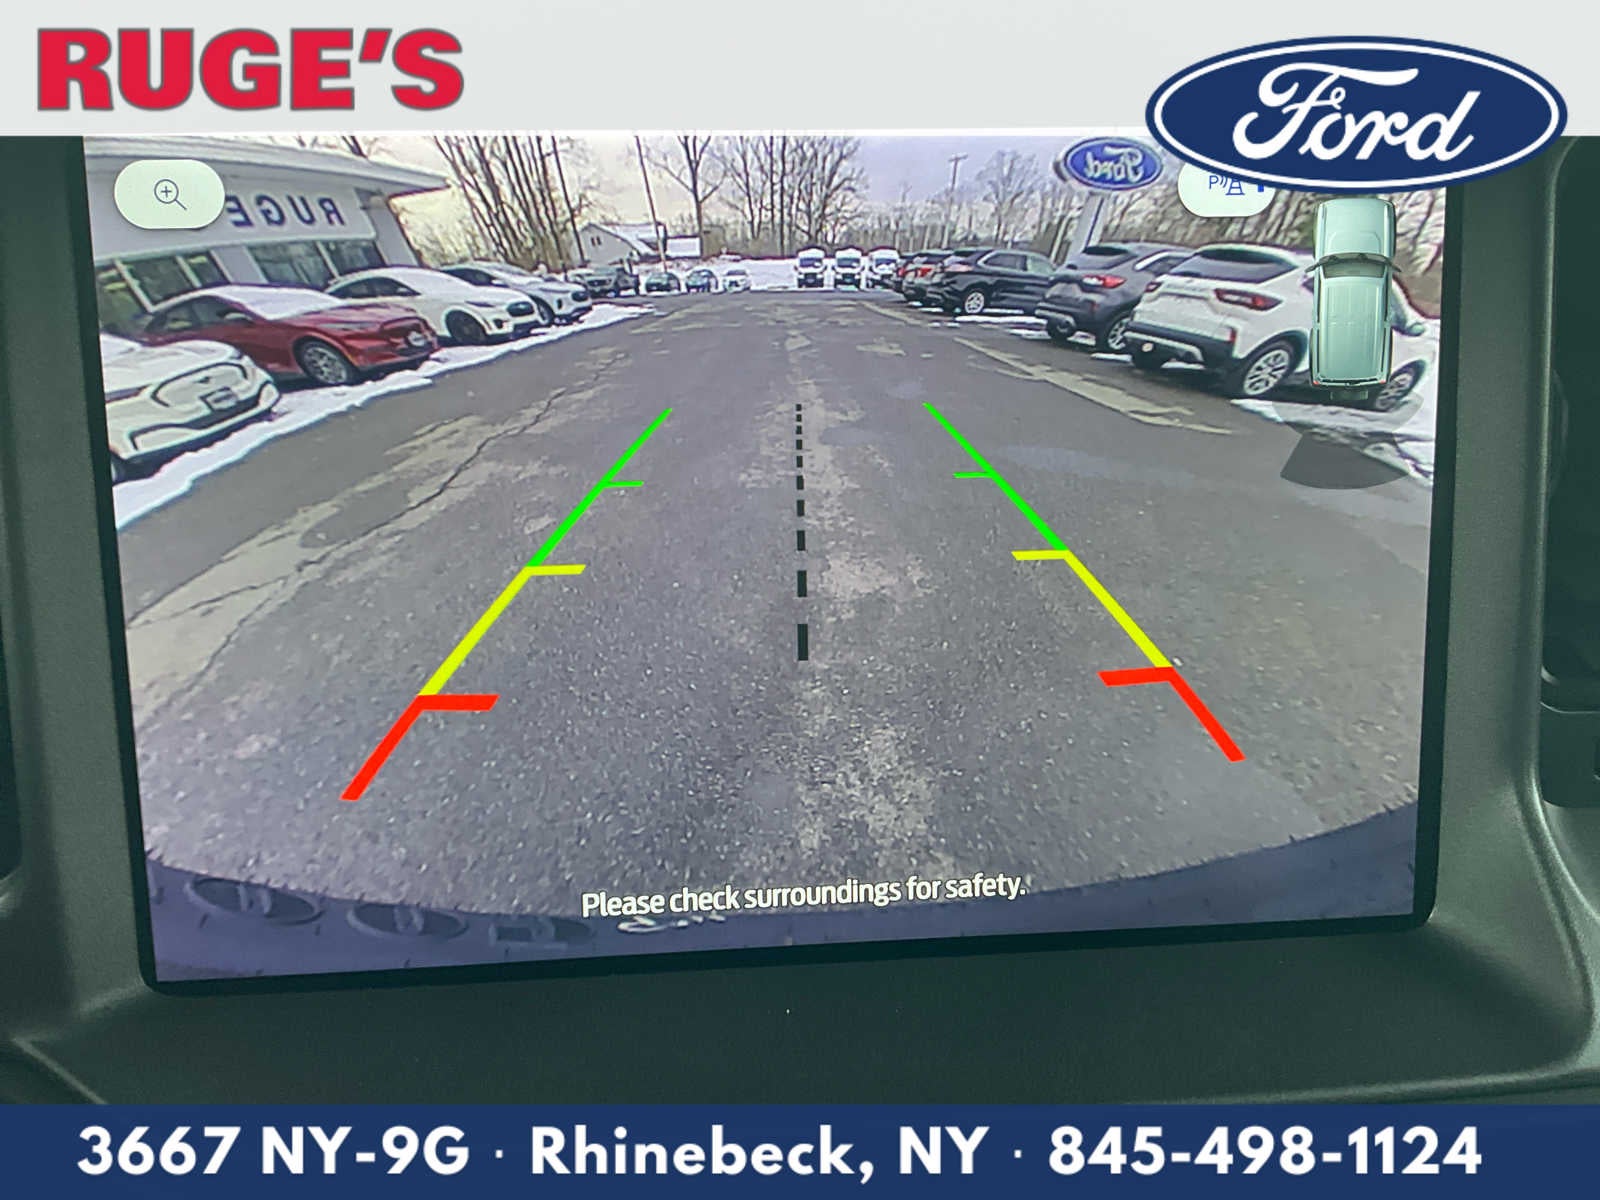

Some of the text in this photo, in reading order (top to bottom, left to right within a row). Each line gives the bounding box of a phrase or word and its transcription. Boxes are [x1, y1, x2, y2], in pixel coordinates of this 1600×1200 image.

[581, 871, 1027, 918] Please check surroundings for safety.
